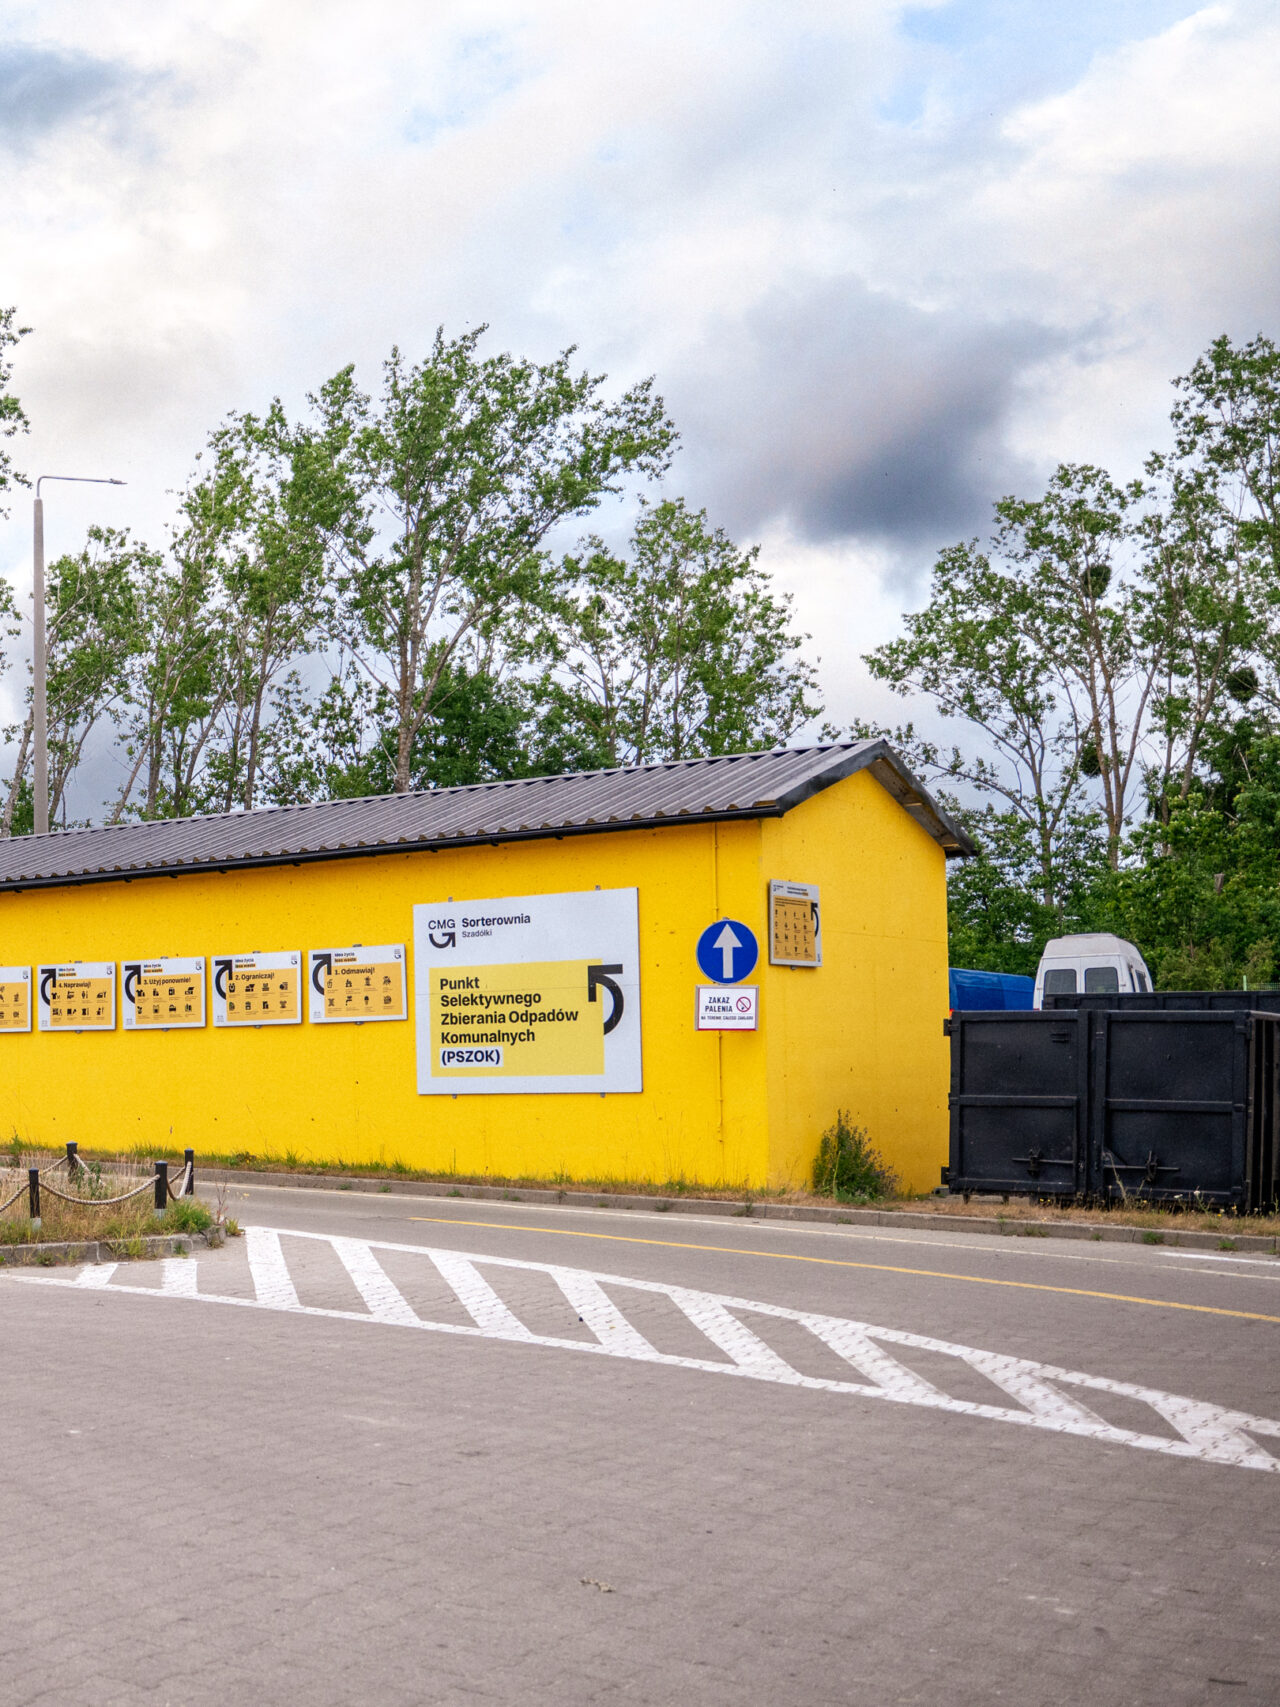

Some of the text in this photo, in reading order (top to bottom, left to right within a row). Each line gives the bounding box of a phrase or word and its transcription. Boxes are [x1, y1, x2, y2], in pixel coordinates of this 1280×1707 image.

[427, 919, 456, 930] CMG
[462, 913, 531, 928] Sorterownia
[241, 972, 275, 981] Ograniczaj!
[341, 967, 375, 975] Odmawiaj!
[63, 981, 92, 989] Naprawiaj!
[149, 978, 161, 986] Użyj
[162, 977, 191, 985] ponownie!
[440, 976, 480, 990] Punkt
[440, 993, 542, 1009] Selektywnego
[441, 1008, 579, 1026] Zbierania Odpadów
[441, 1029, 535, 1046] Komunalnych
[441, 1049, 501, 1065] (PSZOK)
